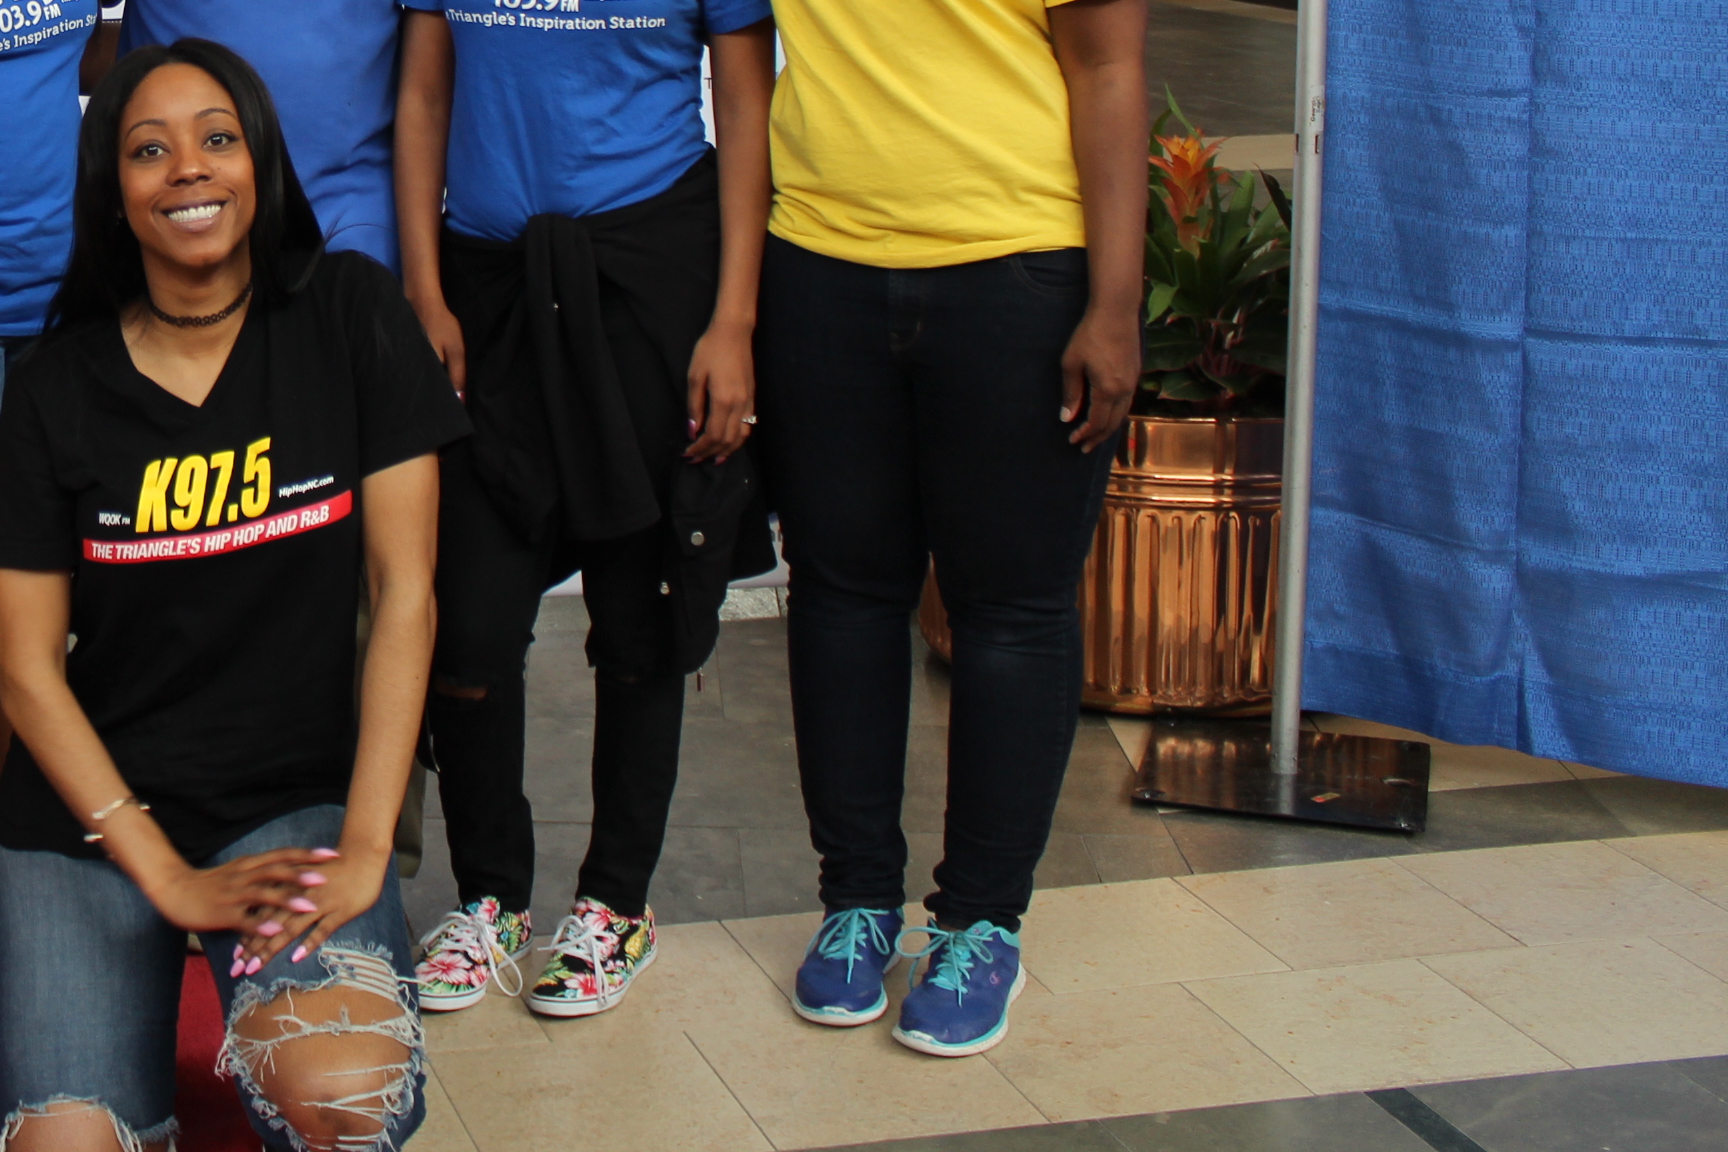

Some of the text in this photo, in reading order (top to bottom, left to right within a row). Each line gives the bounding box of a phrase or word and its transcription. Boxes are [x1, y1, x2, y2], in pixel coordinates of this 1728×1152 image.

[43, 3, 61, 21] FM
[448, 9, 516, 27] Triangle's
[519, 13, 606, 32] Inspiration
[609, 16, 666, 30] Station
[13, 16, 84, 48] Inspiration
[135, 436, 271, 534] K97.5
[278, 475, 334, 499] HipHopNC.com
[91, 505, 330, 560] THE TRIANGLE'S HIP HOP AND R&B
